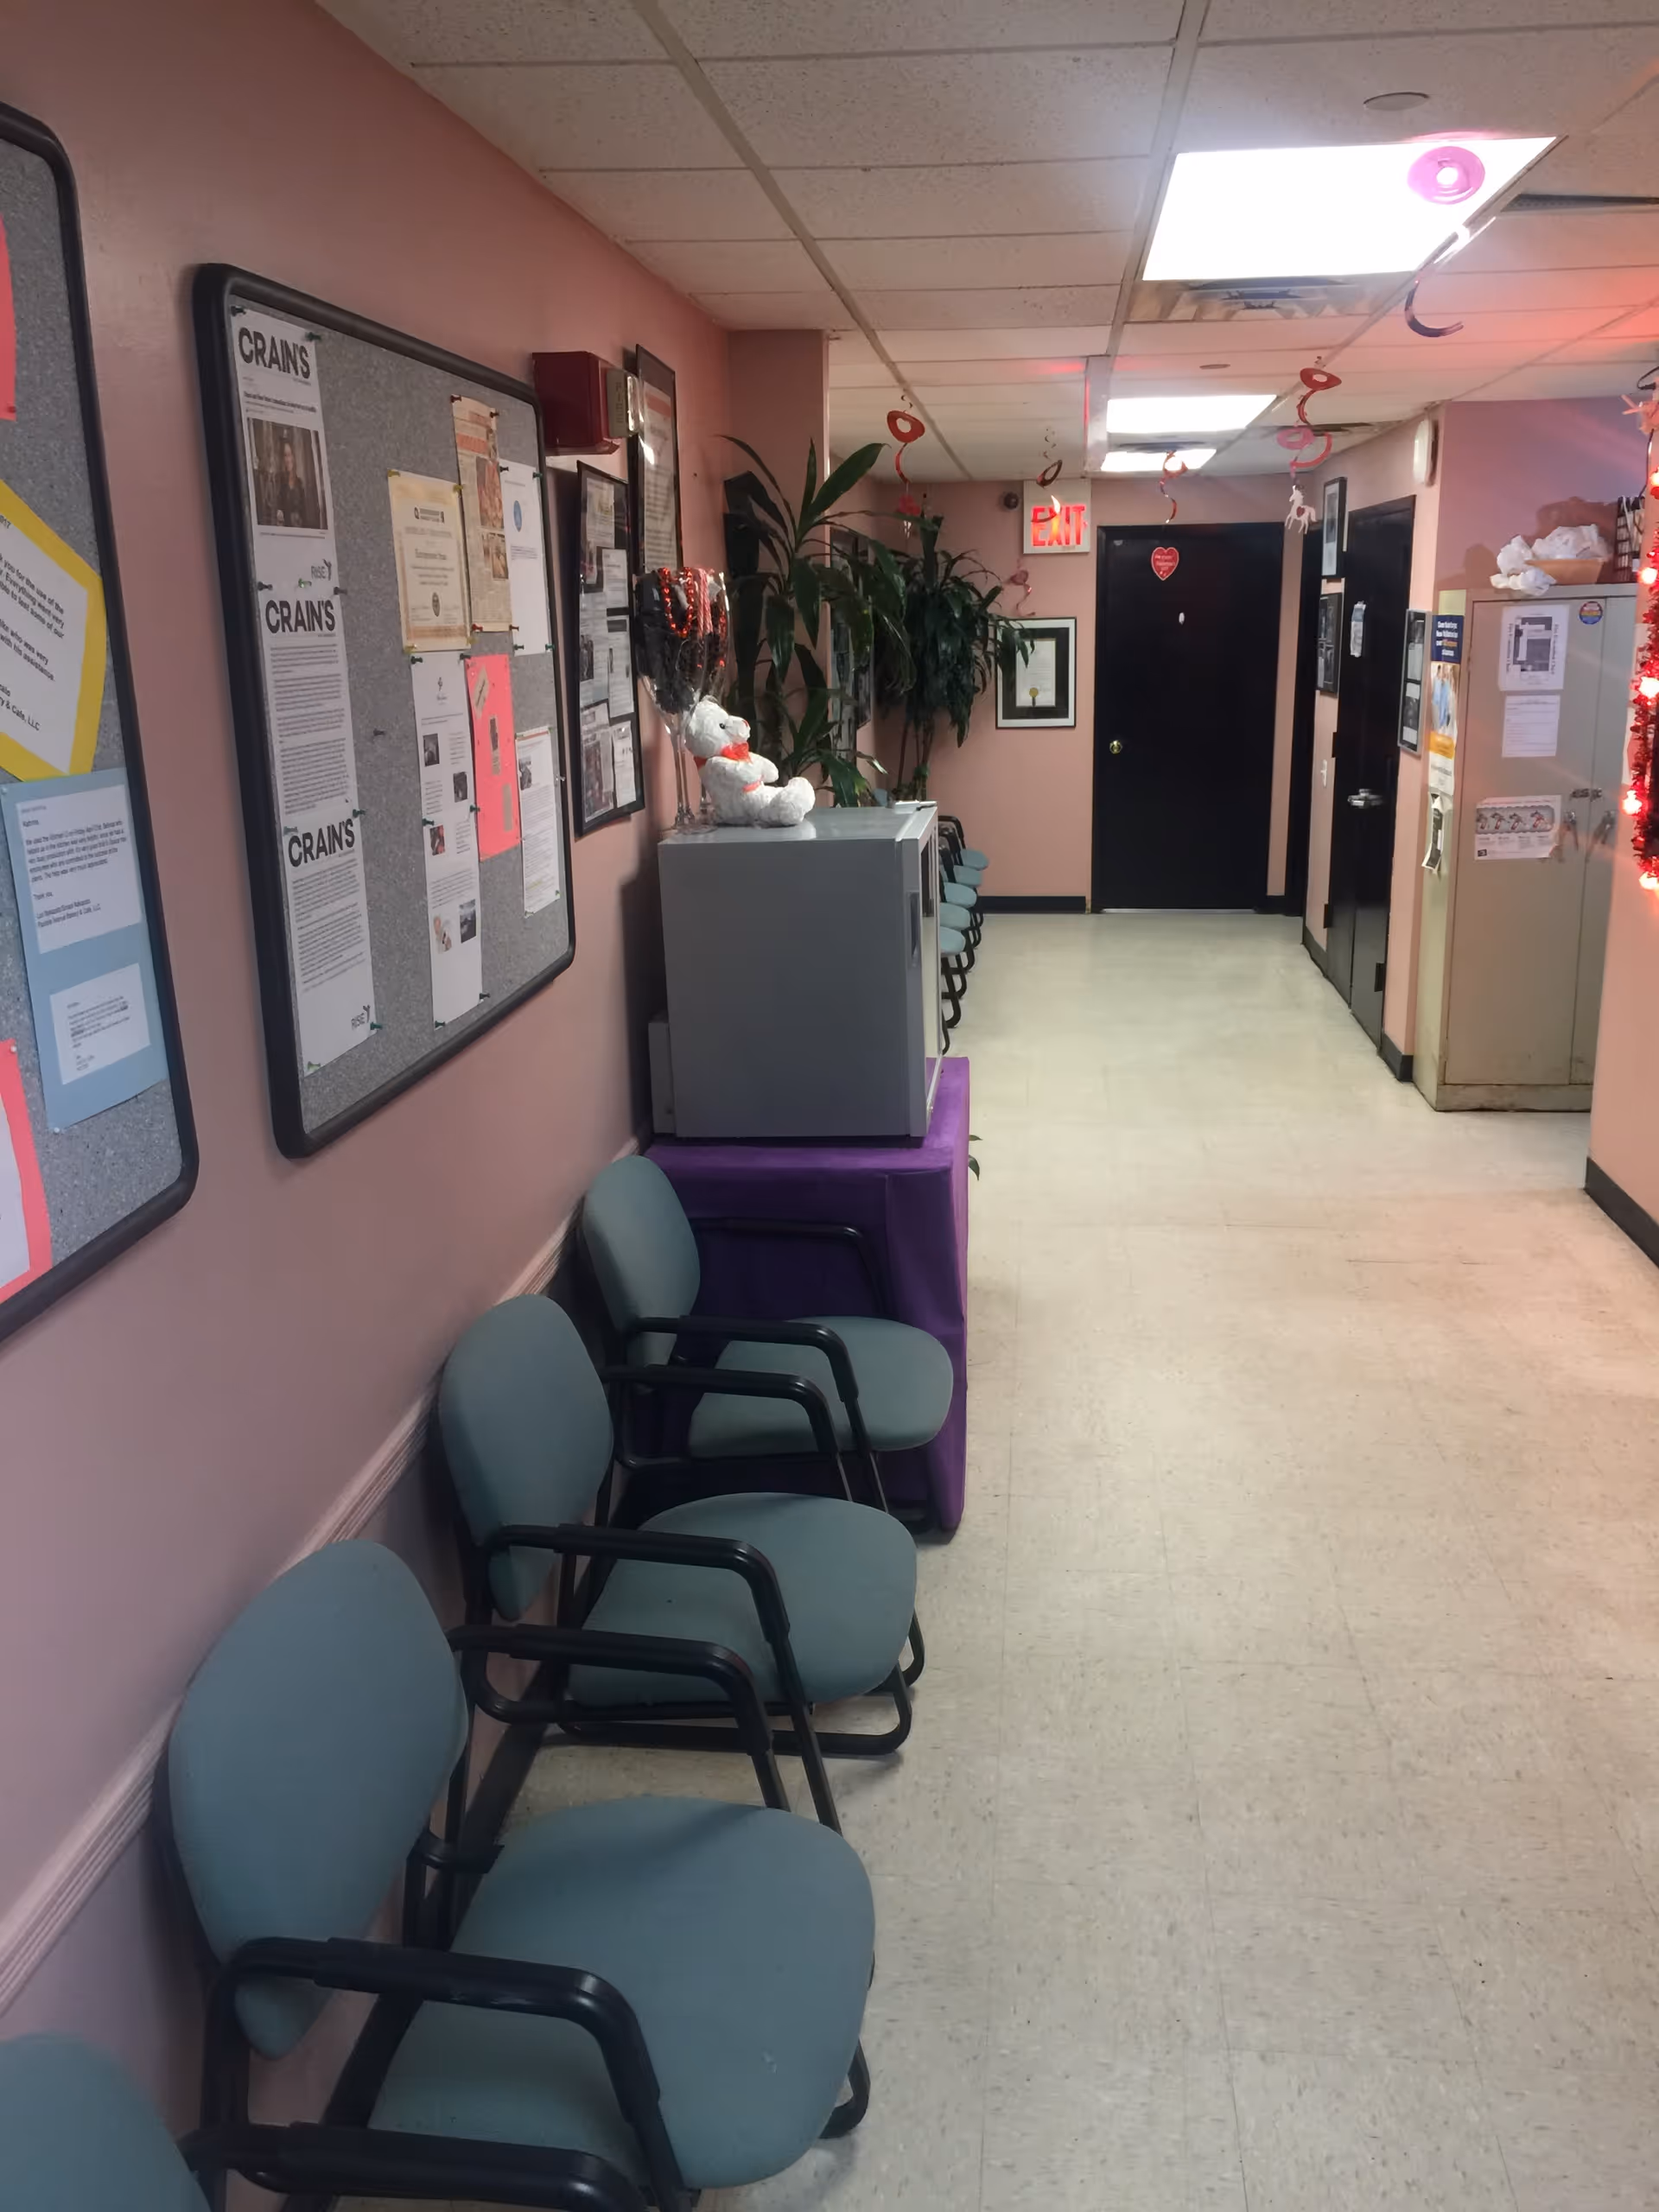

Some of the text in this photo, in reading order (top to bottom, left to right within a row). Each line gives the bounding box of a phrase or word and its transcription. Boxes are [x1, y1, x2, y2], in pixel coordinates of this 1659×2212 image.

[238, 327, 311, 379] CRAIN'S
[1032, 505, 1086, 547] EXIT
[4, 560, 16, 574] you
[16, 569, 25, 581] for
[26, 578, 35, 591] the
[55, 602, 64, 615] the
[6, 572, 37, 606] Everything
[11, 591, 17, 601] to
[47, 622, 53, 631] of
[265, 600, 336, 634] CRAIN'S
[6, 701, 10, 709] &
[28, 715, 40, 731] LLC
[288, 817, 355, 868] CRAIN'S
